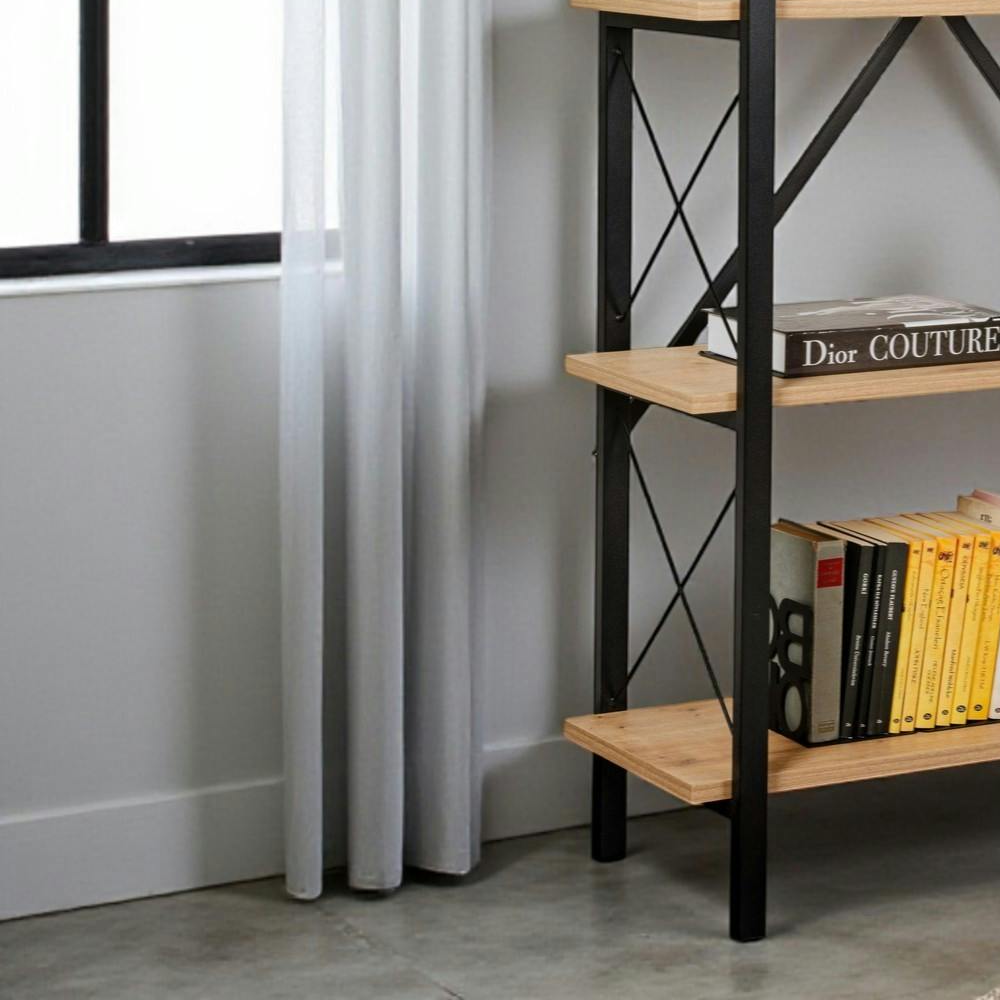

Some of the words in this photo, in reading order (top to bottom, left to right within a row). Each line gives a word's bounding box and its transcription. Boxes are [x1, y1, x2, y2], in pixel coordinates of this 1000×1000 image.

[801, 339, 858, 367] Dior
[869, 326, 1000, 361] COUTURE
[886, 594, 896, 620] FLAUBERT
